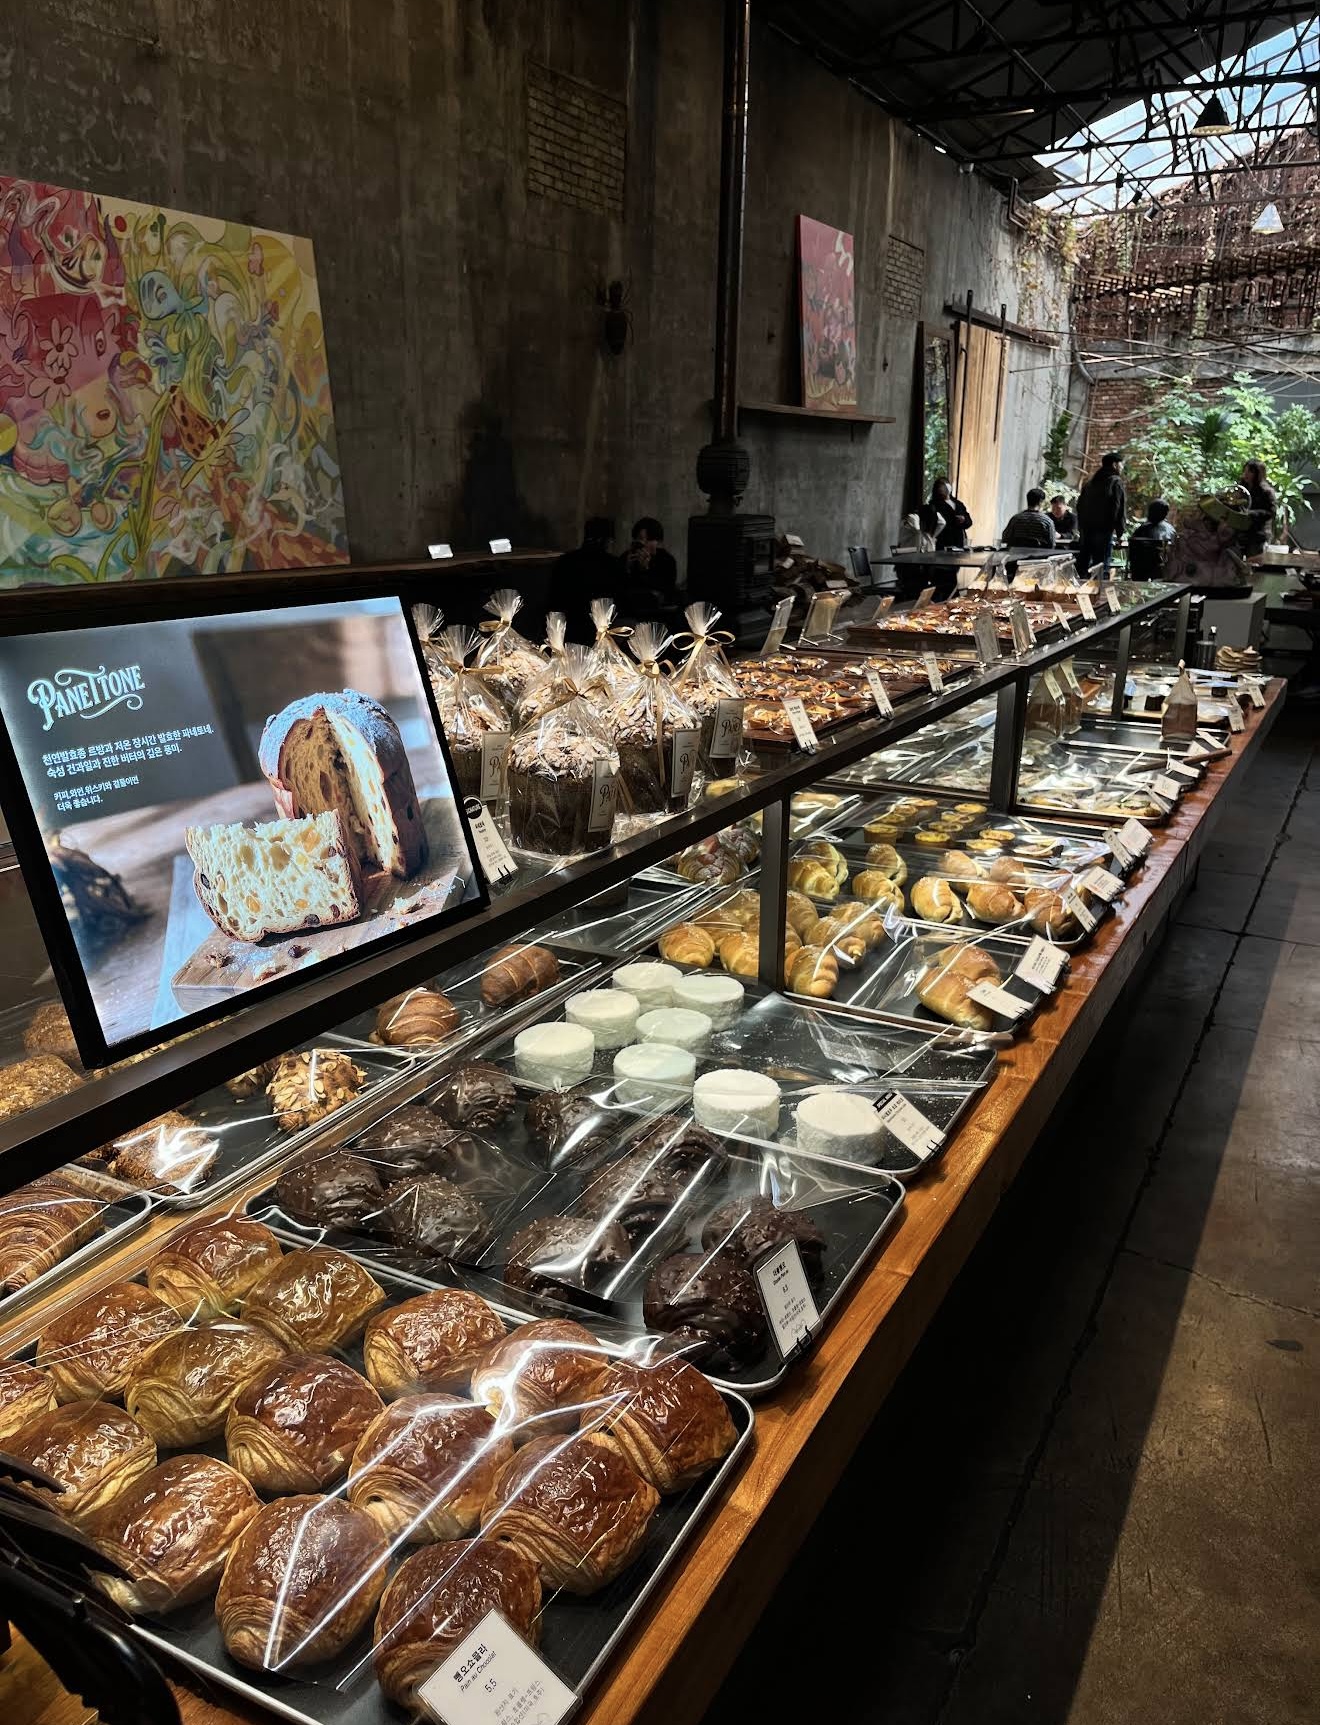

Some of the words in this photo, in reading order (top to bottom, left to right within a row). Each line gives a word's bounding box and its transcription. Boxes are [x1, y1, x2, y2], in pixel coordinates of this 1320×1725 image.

[27, 664, 146, 731] PANETTONE
[42, 747, 87, 766] 천연발효종
[87, 741, 114, 757] 르방과
[115, 740, 132, 752] 저온
[132, 733, 157, 748] 장시간
[157, 728, 181, 744] 발효한
[182, 723, 215, 738] 파네토네.
[46, 765, 66, 779] 숙성
[67, 759, 102, 775] 건과일과
[102, 756, 120, 769] 진한
[120, 750, 146, 765] 버터의
[147, 747, 163, 761] 깊은
[164, 744, 182, 756] 풍미.
[112, 775, 139, 789] 곁들이면
[57, 800, 72, 812] 더욱
[73, 795, 103, 809] 좋습니다.
[460, 1679, 472, 1692] Pain
[483, 1678, 497, 1693] 5.5
